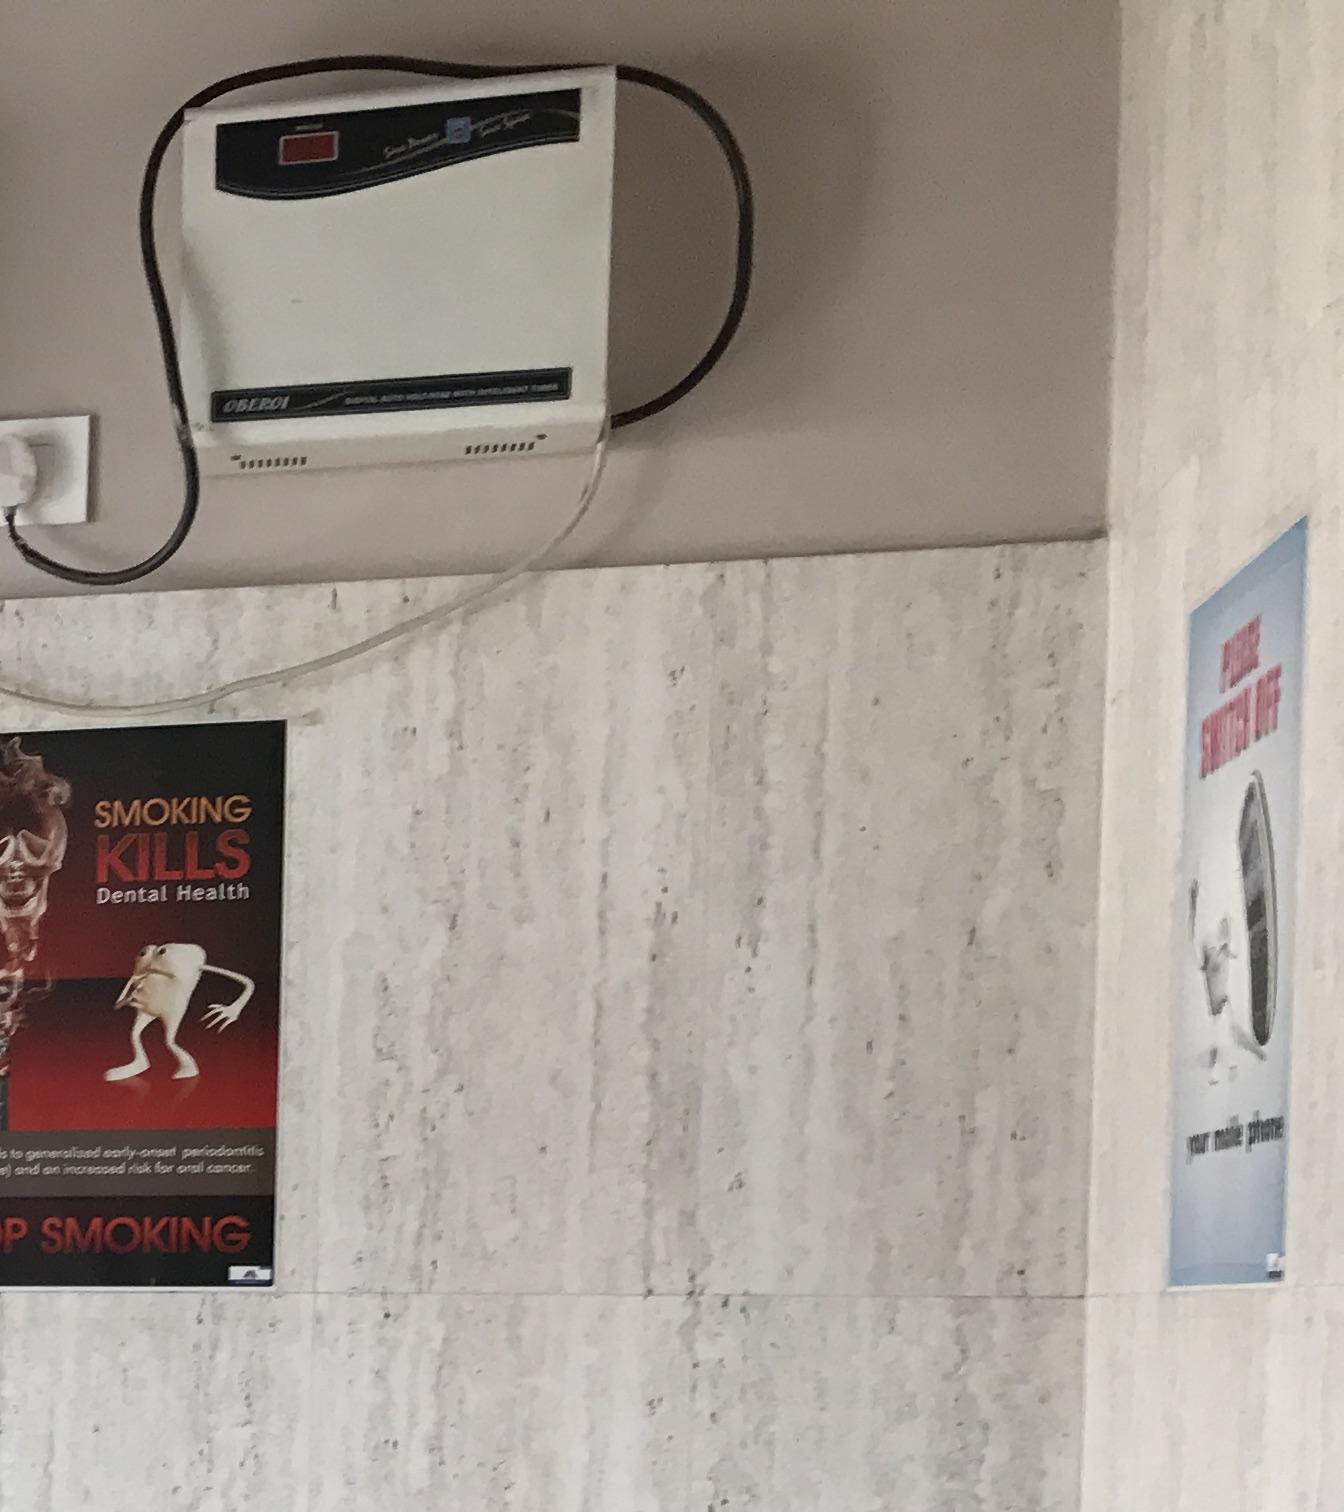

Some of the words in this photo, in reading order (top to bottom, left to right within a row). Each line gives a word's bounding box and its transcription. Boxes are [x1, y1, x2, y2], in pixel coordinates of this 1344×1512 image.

[223, 396, 290, 413] OBEROI
[94, 795, 252, 829] SMOKING
[95, 829, 250, 884] KILLS
[96, 885, 168, 905] Dental
[176, 881, 250, 902] Health
[9, 1149, 22, 1160] to
[15, 1163, 40, 1176] and
[42, 1165, 61, 1176] an
[63, 1161, 126, 1176] increased
[128, 1161, 151, 1175] risk
[154, 1161, 175, 1174] for
[176, 1161, 204, 1174] oral
[40, 1214, 252, 1255] SMOKING
